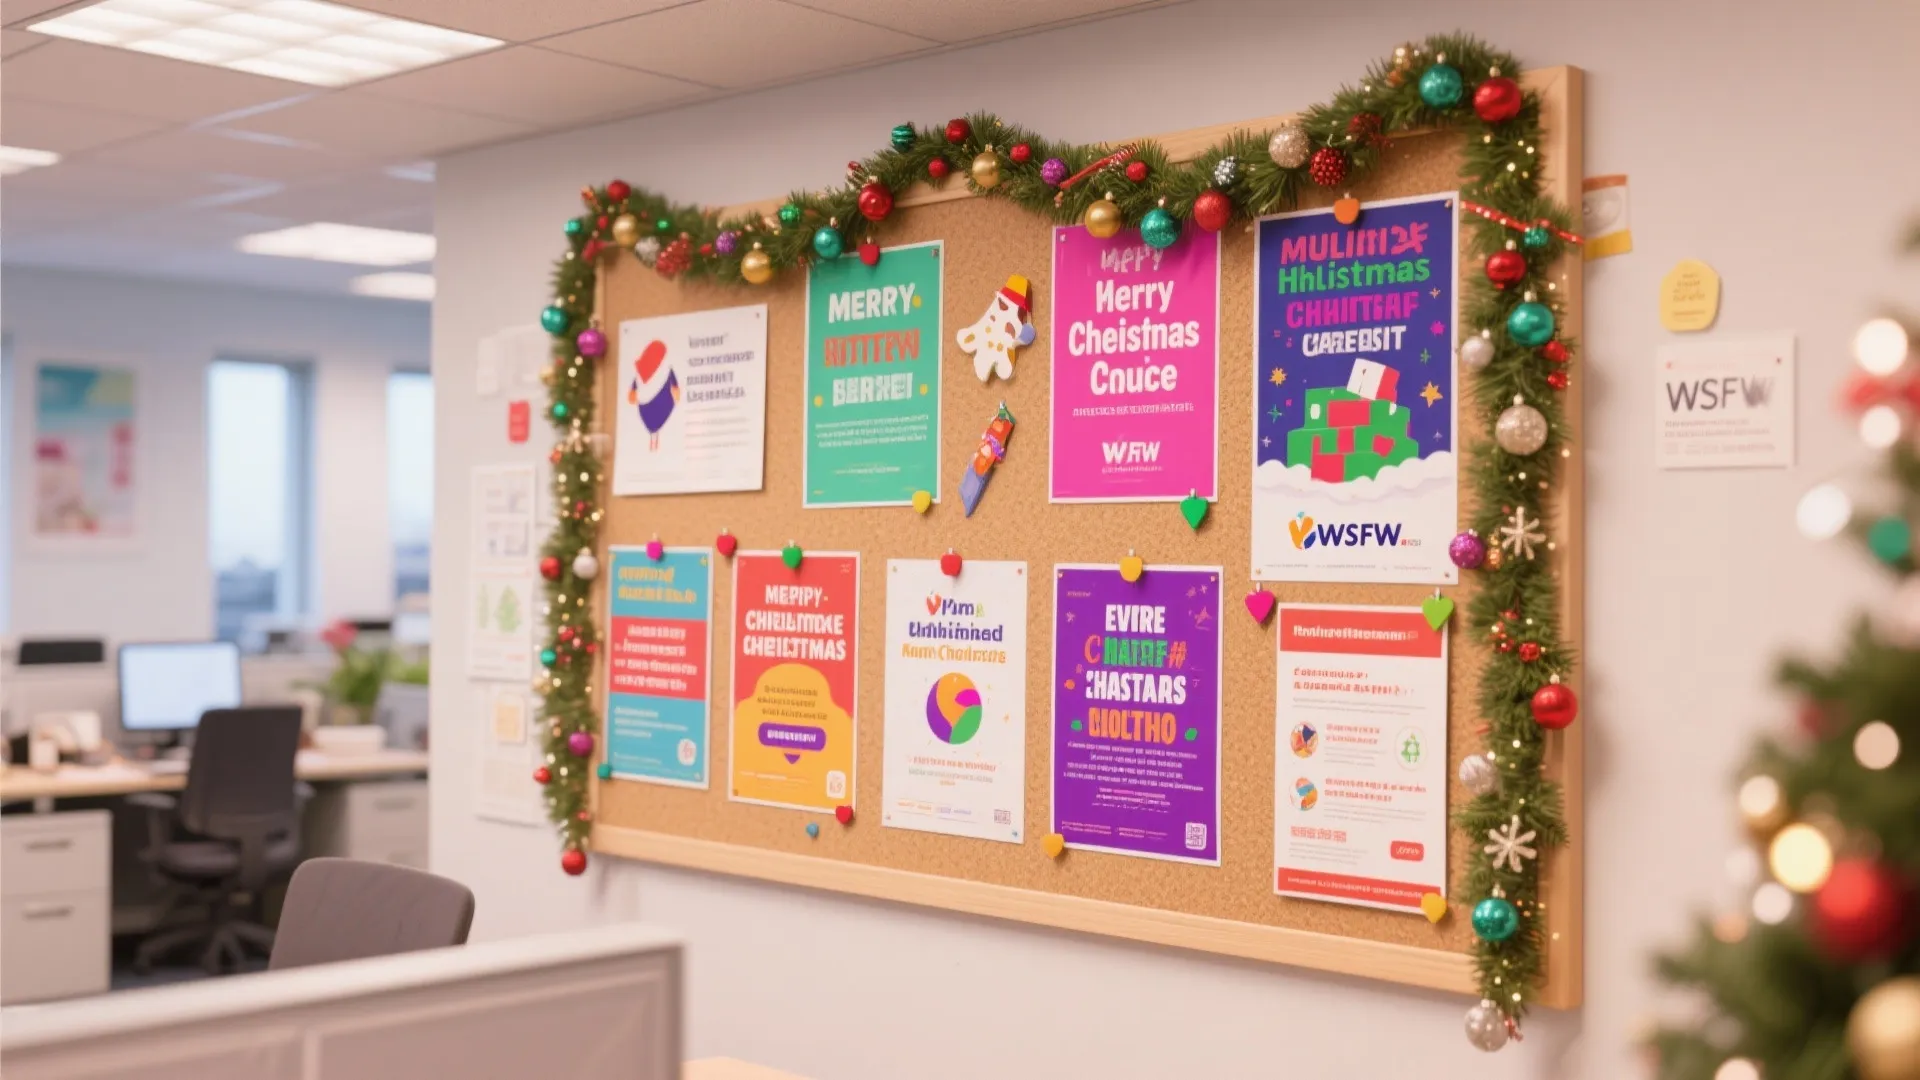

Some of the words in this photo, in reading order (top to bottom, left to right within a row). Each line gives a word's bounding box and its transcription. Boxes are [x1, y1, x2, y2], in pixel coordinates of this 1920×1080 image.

[828, 282, 916, 324] MERRY
[1095, 279, 1175, 314] Merry
[1317, 523, 1403, 547] WSFW
[1105, 604, 1166, 633] EVIRE
